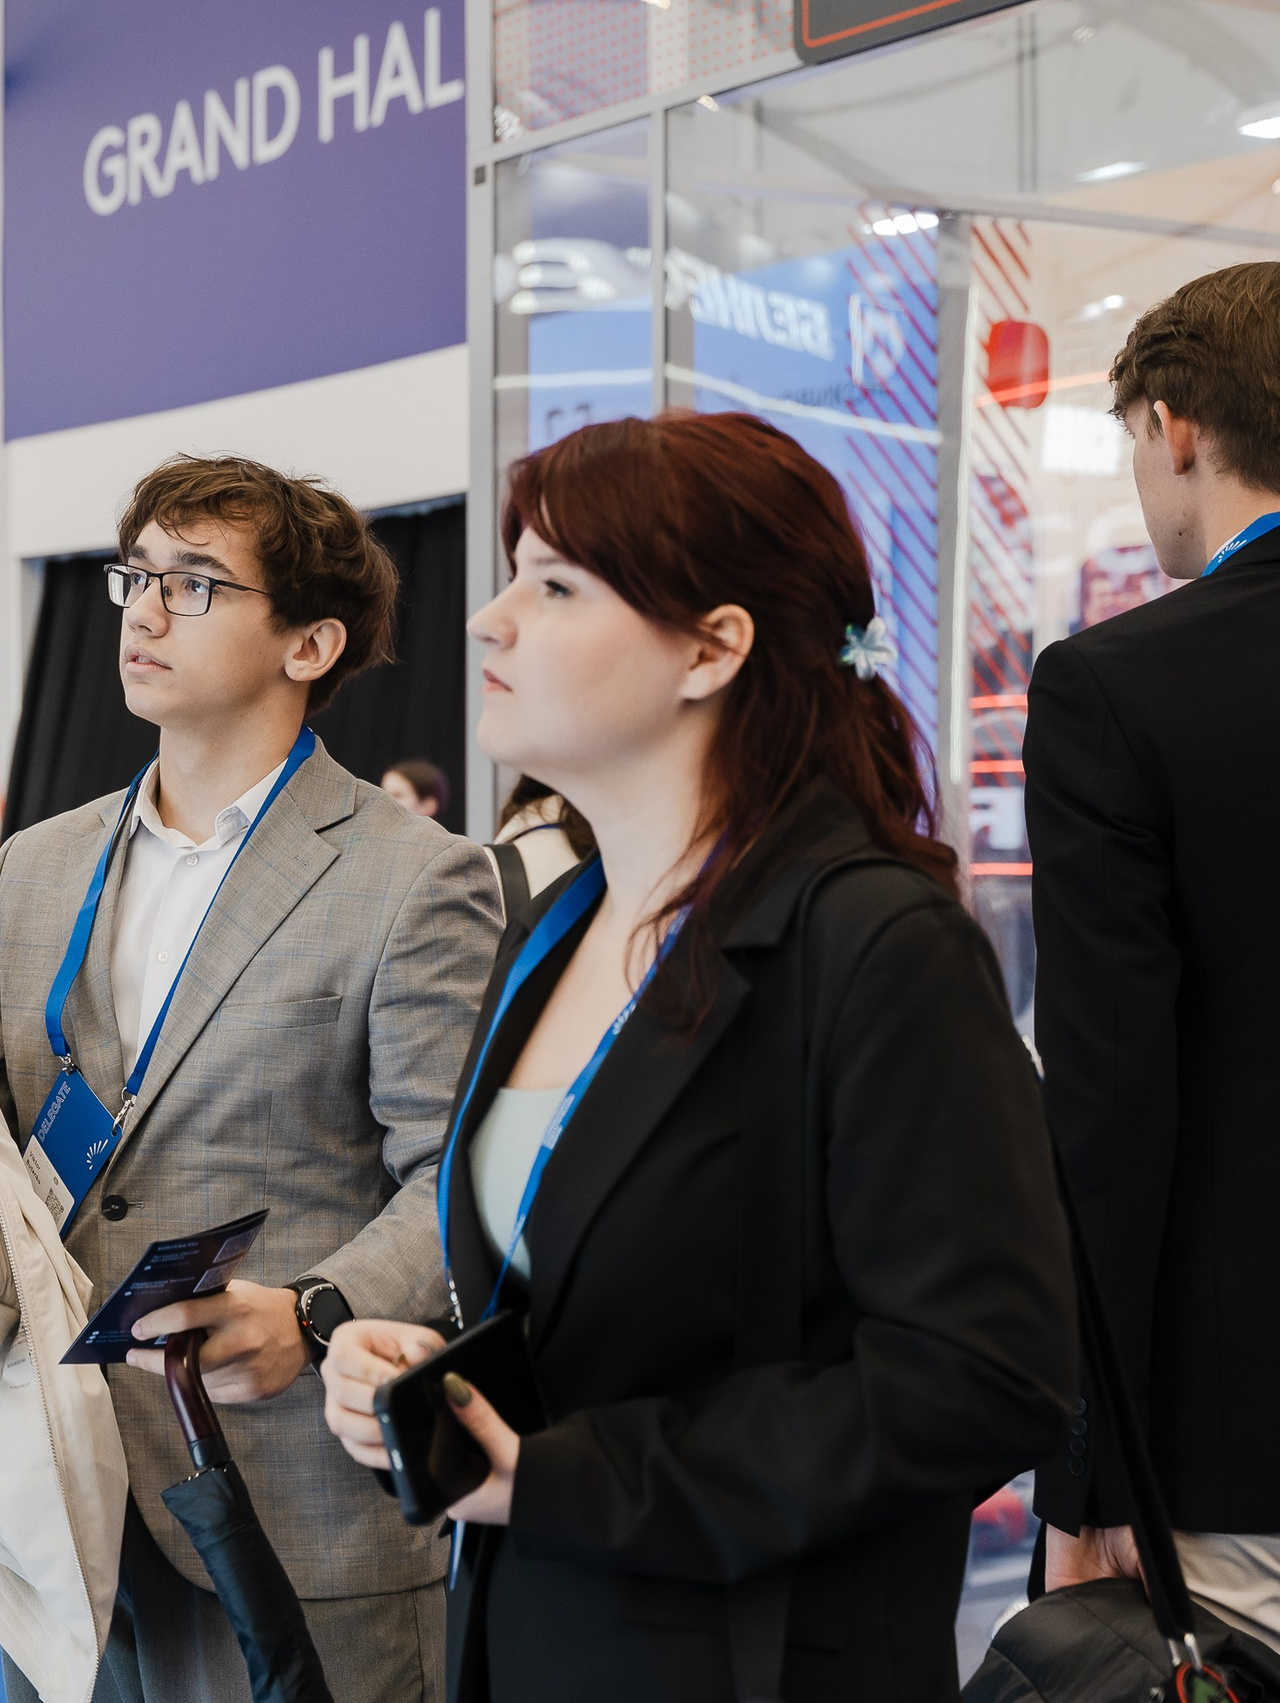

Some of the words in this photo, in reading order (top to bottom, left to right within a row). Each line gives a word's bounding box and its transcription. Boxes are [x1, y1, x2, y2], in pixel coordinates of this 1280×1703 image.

[83, 65, 301, 216] GRAND
[319, 7, 465, 143] HAL
[37, 1081, 71, 1142] DELEGATE
